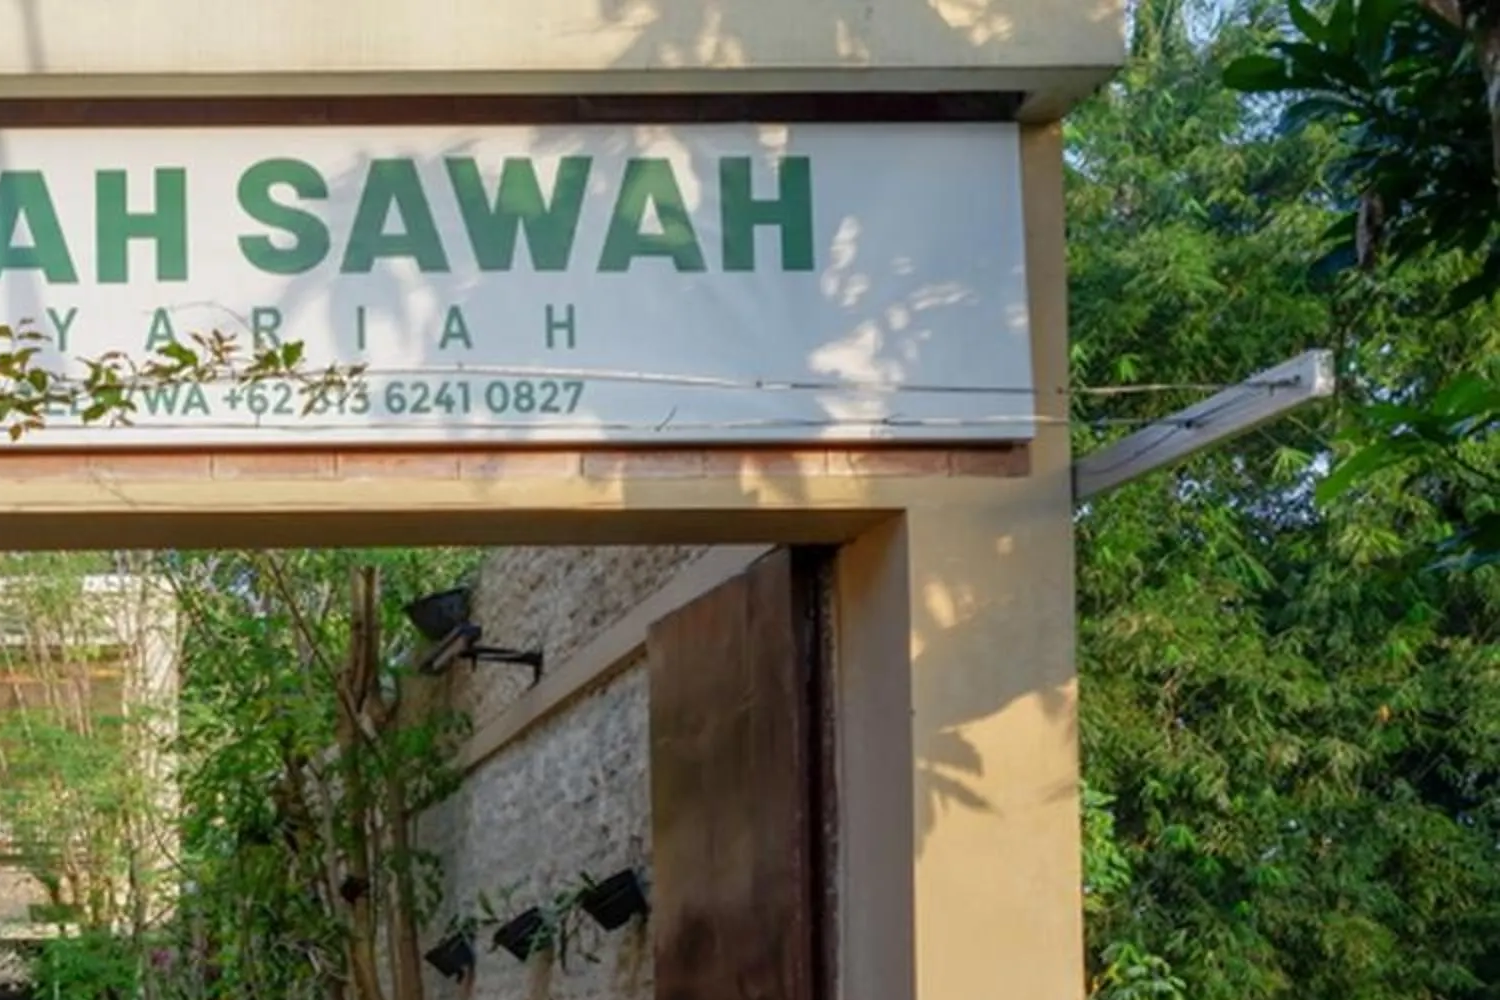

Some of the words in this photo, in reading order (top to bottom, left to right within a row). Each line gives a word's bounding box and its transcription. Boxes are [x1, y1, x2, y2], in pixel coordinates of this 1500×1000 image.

[237, 156, 816, 275] SAWAH
[223, 381, 294, 414] +62
[385, 381, 471, 413] 6241
[485, 380, 585, 413] 0827
